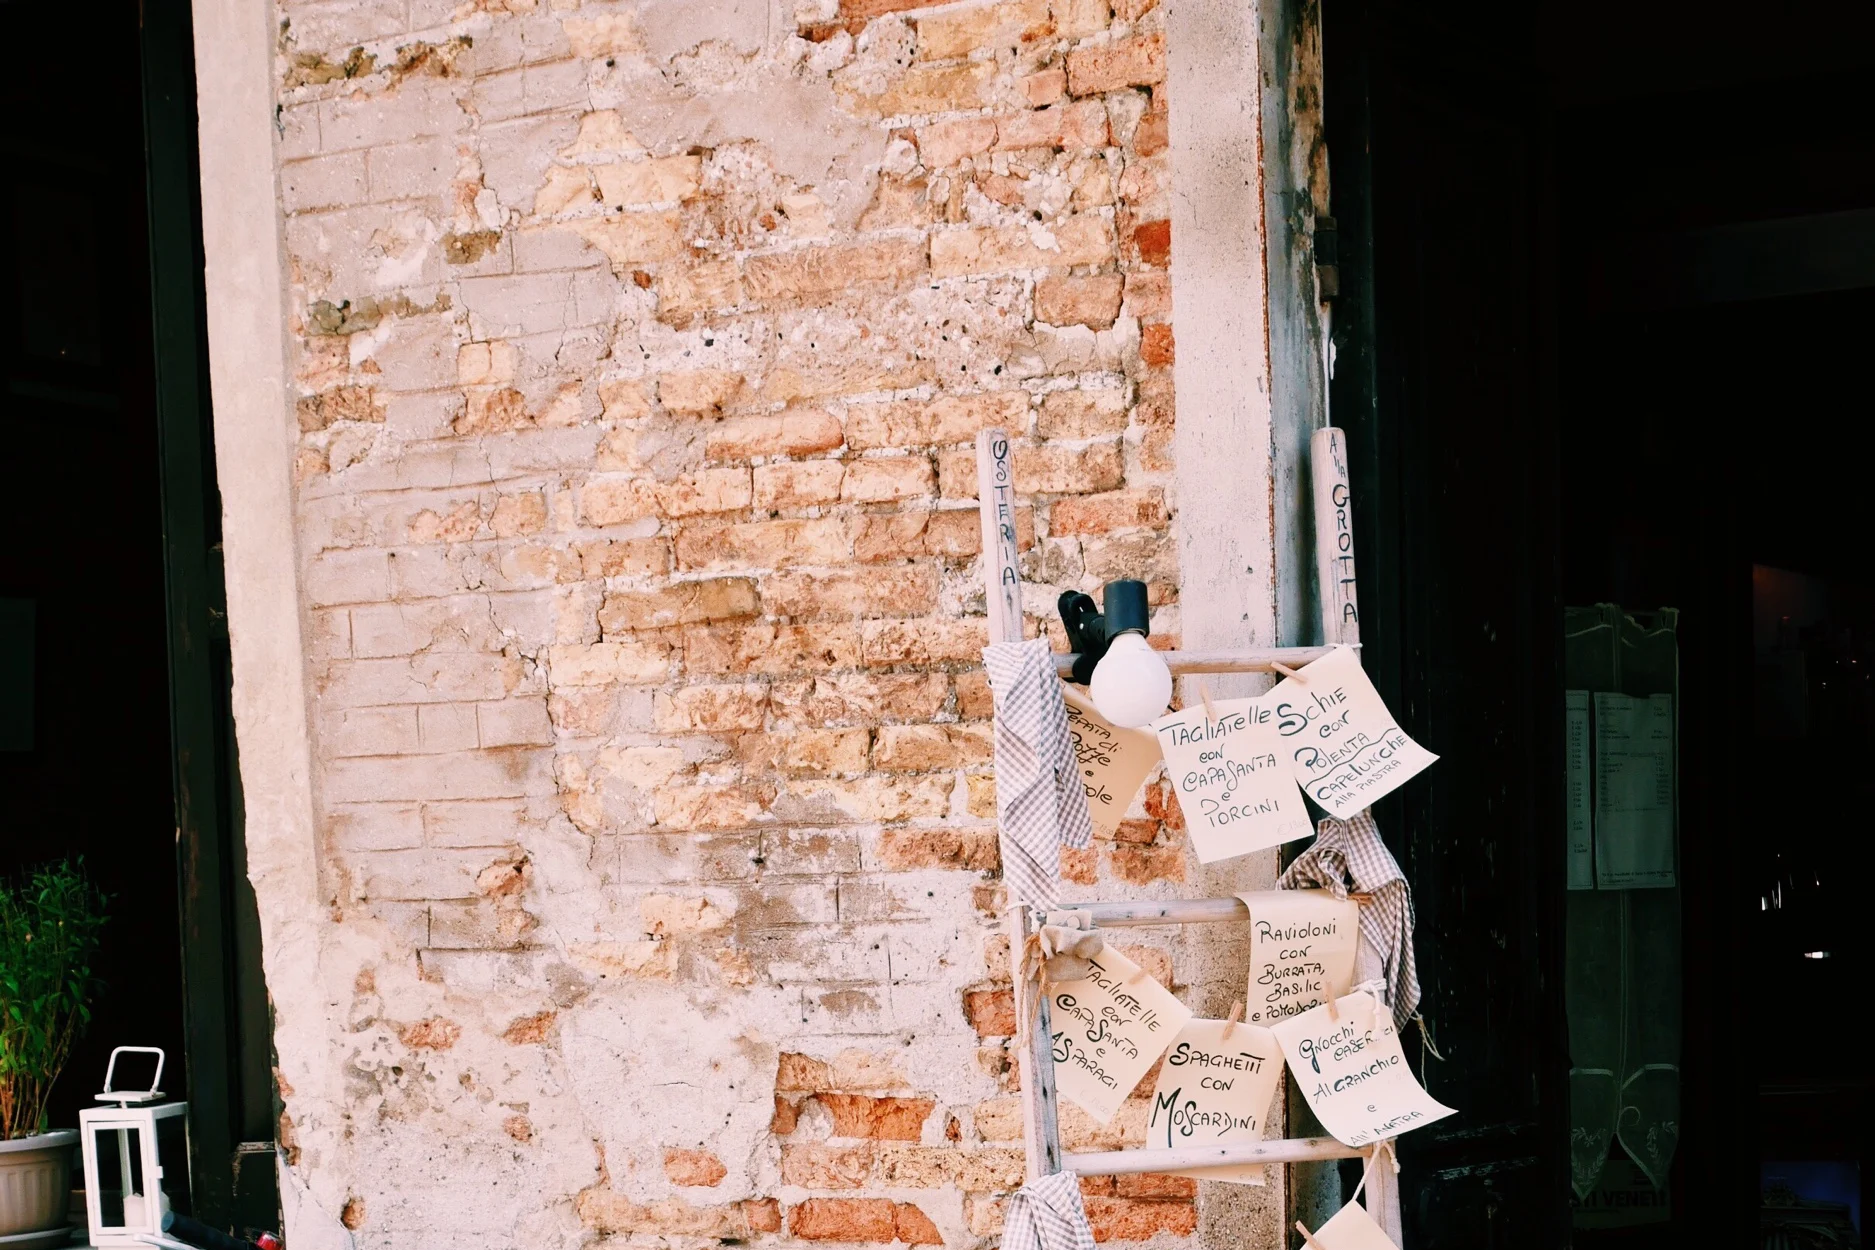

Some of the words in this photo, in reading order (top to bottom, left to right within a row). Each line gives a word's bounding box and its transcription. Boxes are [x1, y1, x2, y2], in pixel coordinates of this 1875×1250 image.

[993, 440, 1016, 586] OSTERIA
[1332, 483, 1359, 624] GROTTA
[1200, 798, 1280, 827] PORCINI
[1280, 945, 1312, 960] CON
[1052, 1031, 1118, 1090] ASPARAGI
[1200, 1077, 1235, 1091] CON
[1151, 1087, 1256, 1148] MOSCARDINI
